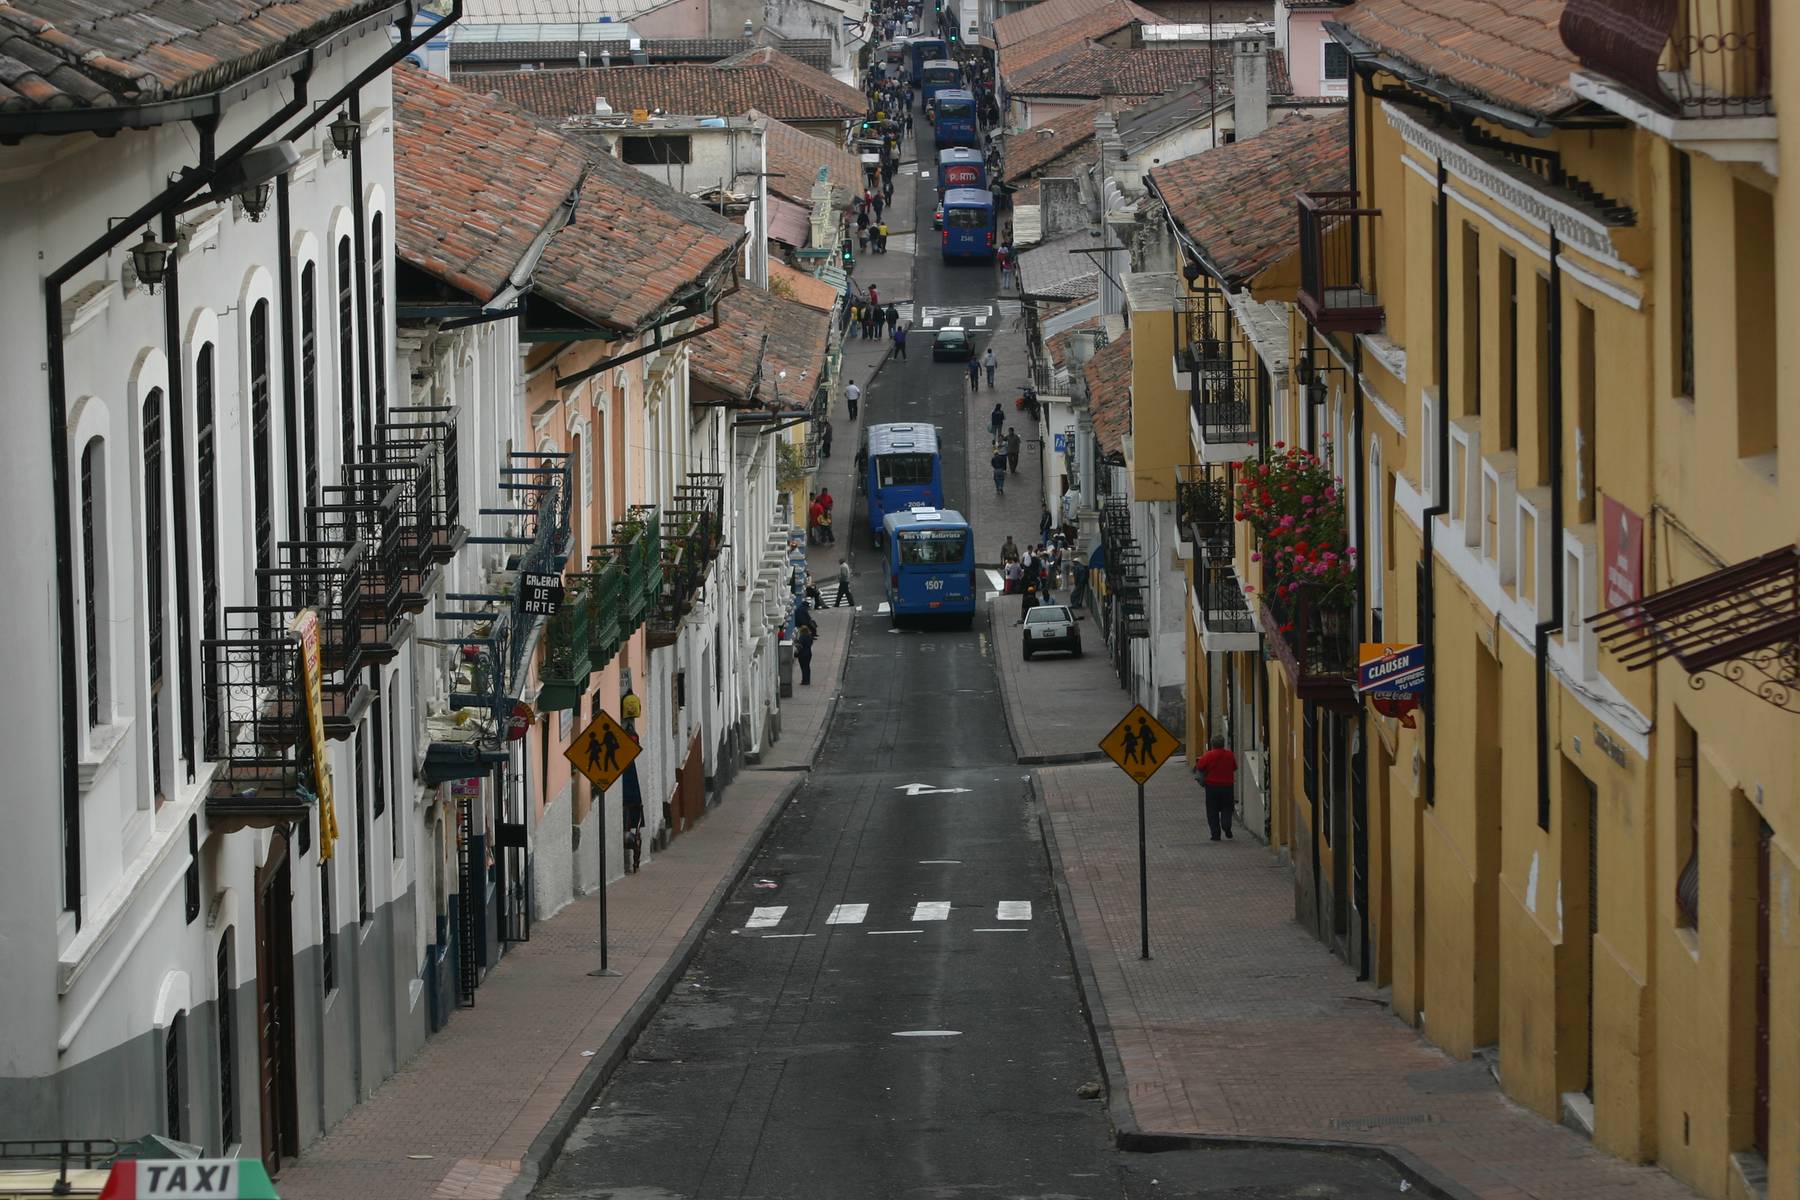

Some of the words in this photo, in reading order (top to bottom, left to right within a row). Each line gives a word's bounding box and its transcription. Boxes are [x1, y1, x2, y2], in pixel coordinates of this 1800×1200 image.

[925, 580, 944, 590] 1507
[534, 588, 549, 600] DE
[525, 600, 555, 614] ARTE
[1369, 656, 1409, 679] CLAUSEN
[147, 1165, 231, 1193] TAXI
